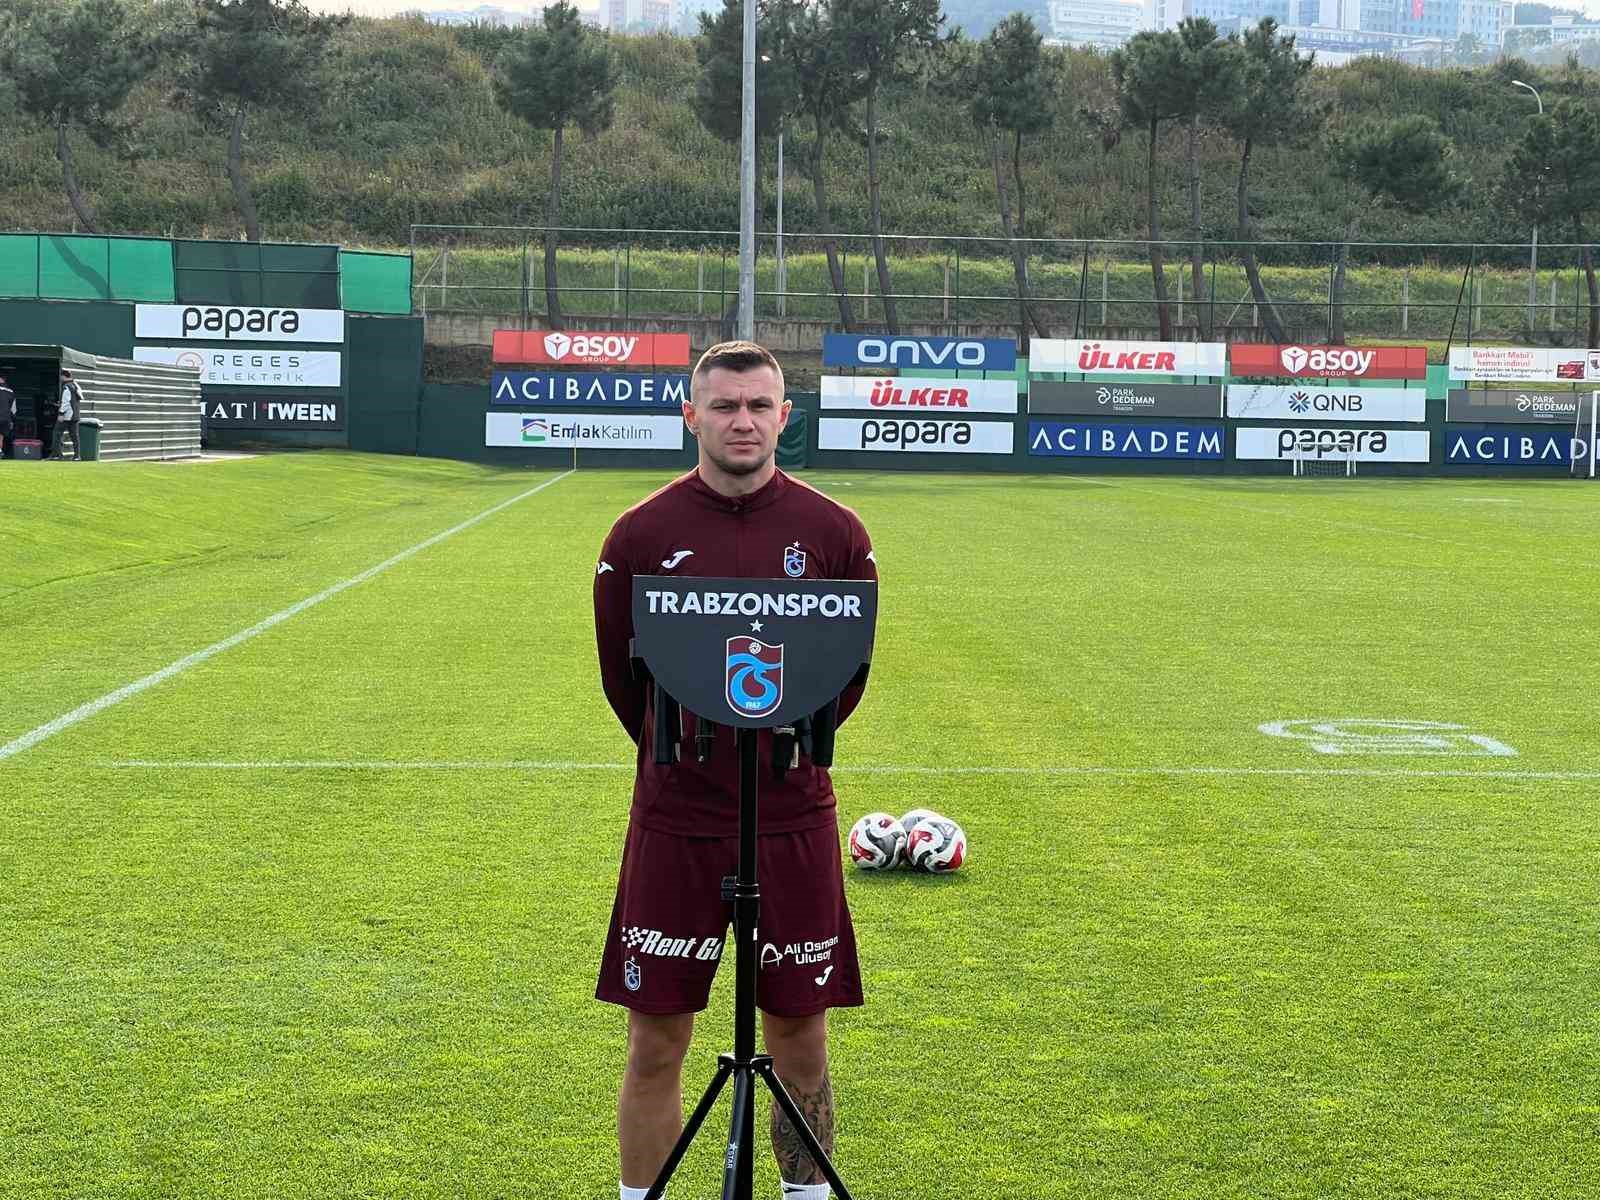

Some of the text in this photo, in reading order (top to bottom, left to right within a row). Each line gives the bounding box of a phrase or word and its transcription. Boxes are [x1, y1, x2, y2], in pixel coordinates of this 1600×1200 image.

[182, 307, 299, 338] papara
[572, 336, 637, 361] asoy
[1078, 344, 1176, 371] ÜLKER
[213, 354, 300, 368] REGES
[1309, 350, 1374, 375] asoy
[496, 377, 686, 401] ACIBADEM
[870, 380, 968, 407] ÜLKER
[1112, 388, 1134, 396] PARK
[1112, 396, 1155, 404] DEDEMAN
[1532, 395, 1554, 403] PARK
[267, 402, 336, 421] TWEEN
[1314, 394, 1362, 412] QNB
[1532, 403, 1576, 411] DEDEMAN
[861, 420, 971, 449] papara
[1032, 427, 1221, 454] ACIBADEM
[1278, 429, 1387, 458] papara
[645, 591, 862, 618] TRABZONSPOR
[640, 930, 697, 958] Rent
[784, 935, 839, 955] Ali Osman
[795, 948, 832, 965] Ulusoy
